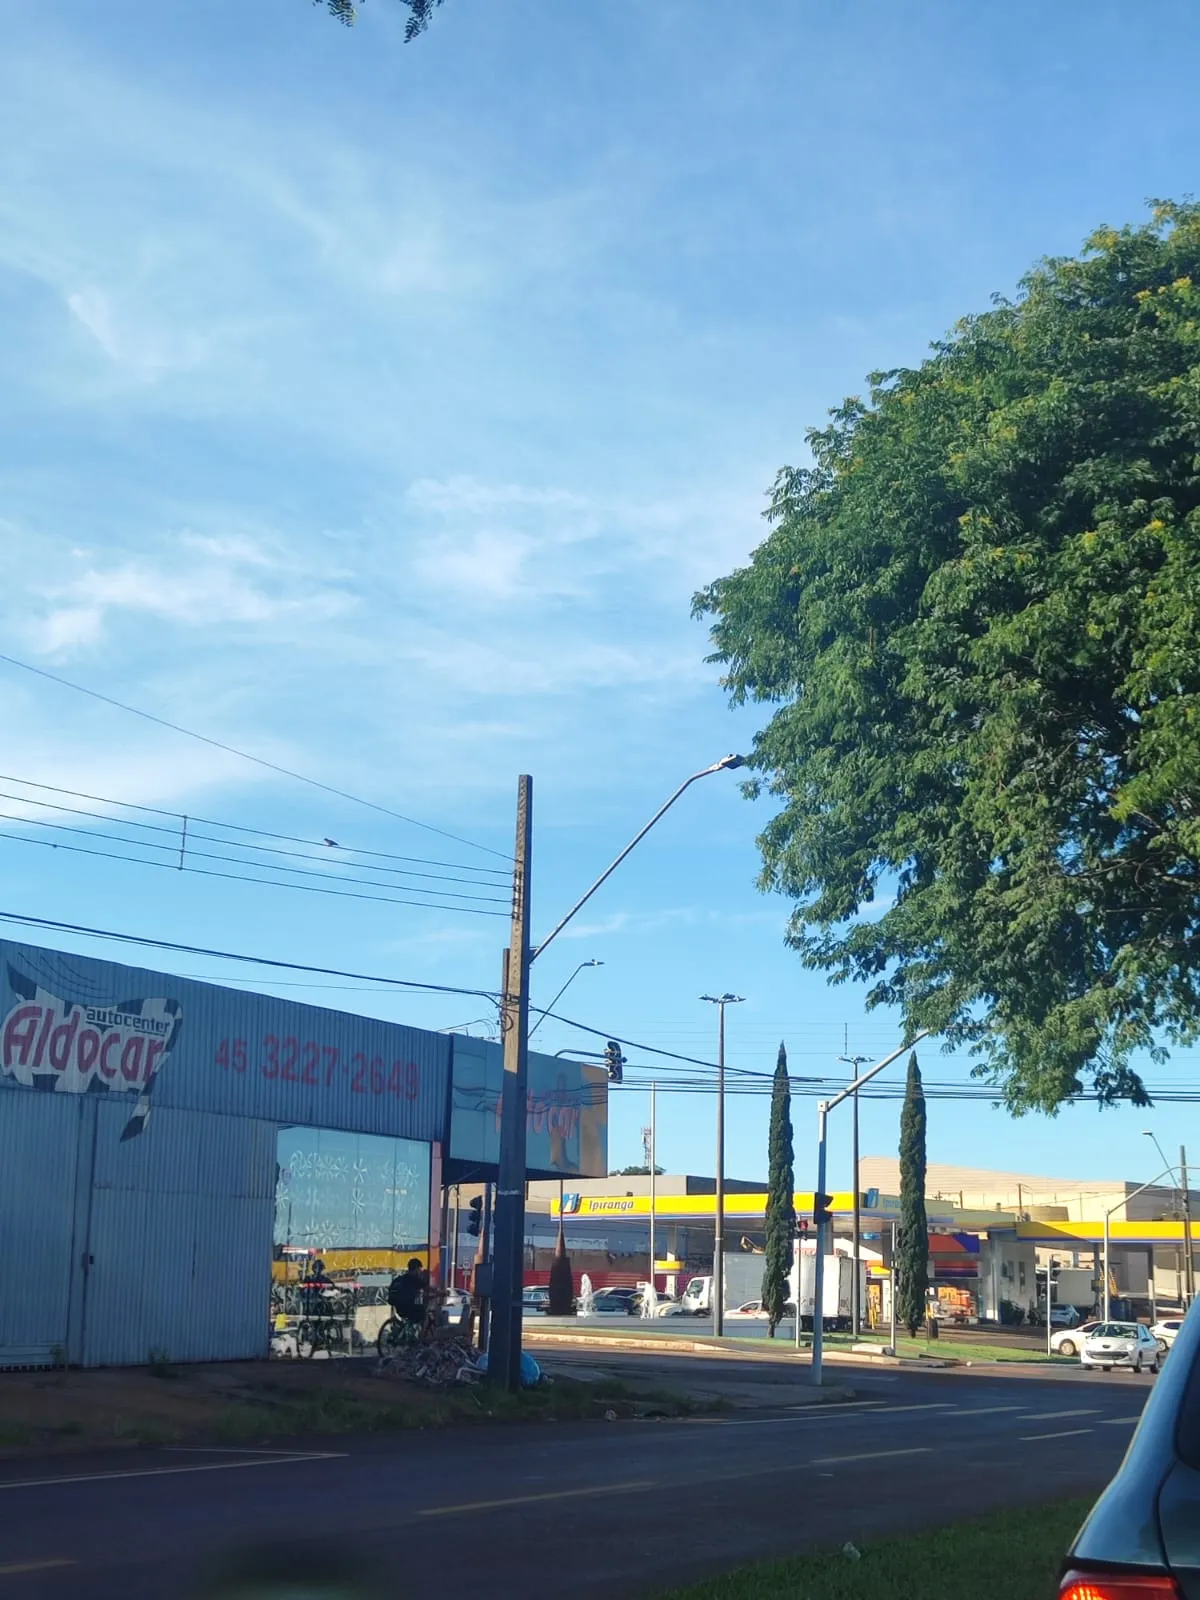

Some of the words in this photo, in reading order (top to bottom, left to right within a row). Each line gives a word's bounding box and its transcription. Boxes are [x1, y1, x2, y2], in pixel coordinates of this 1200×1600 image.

[86, 1007, 171, 1034] autocenter
[3, 1005, 165, 1083] Aldocar
[214, 1036, 248, 1073] 45
[589, 1200, 634, 1211] Ipiranga
